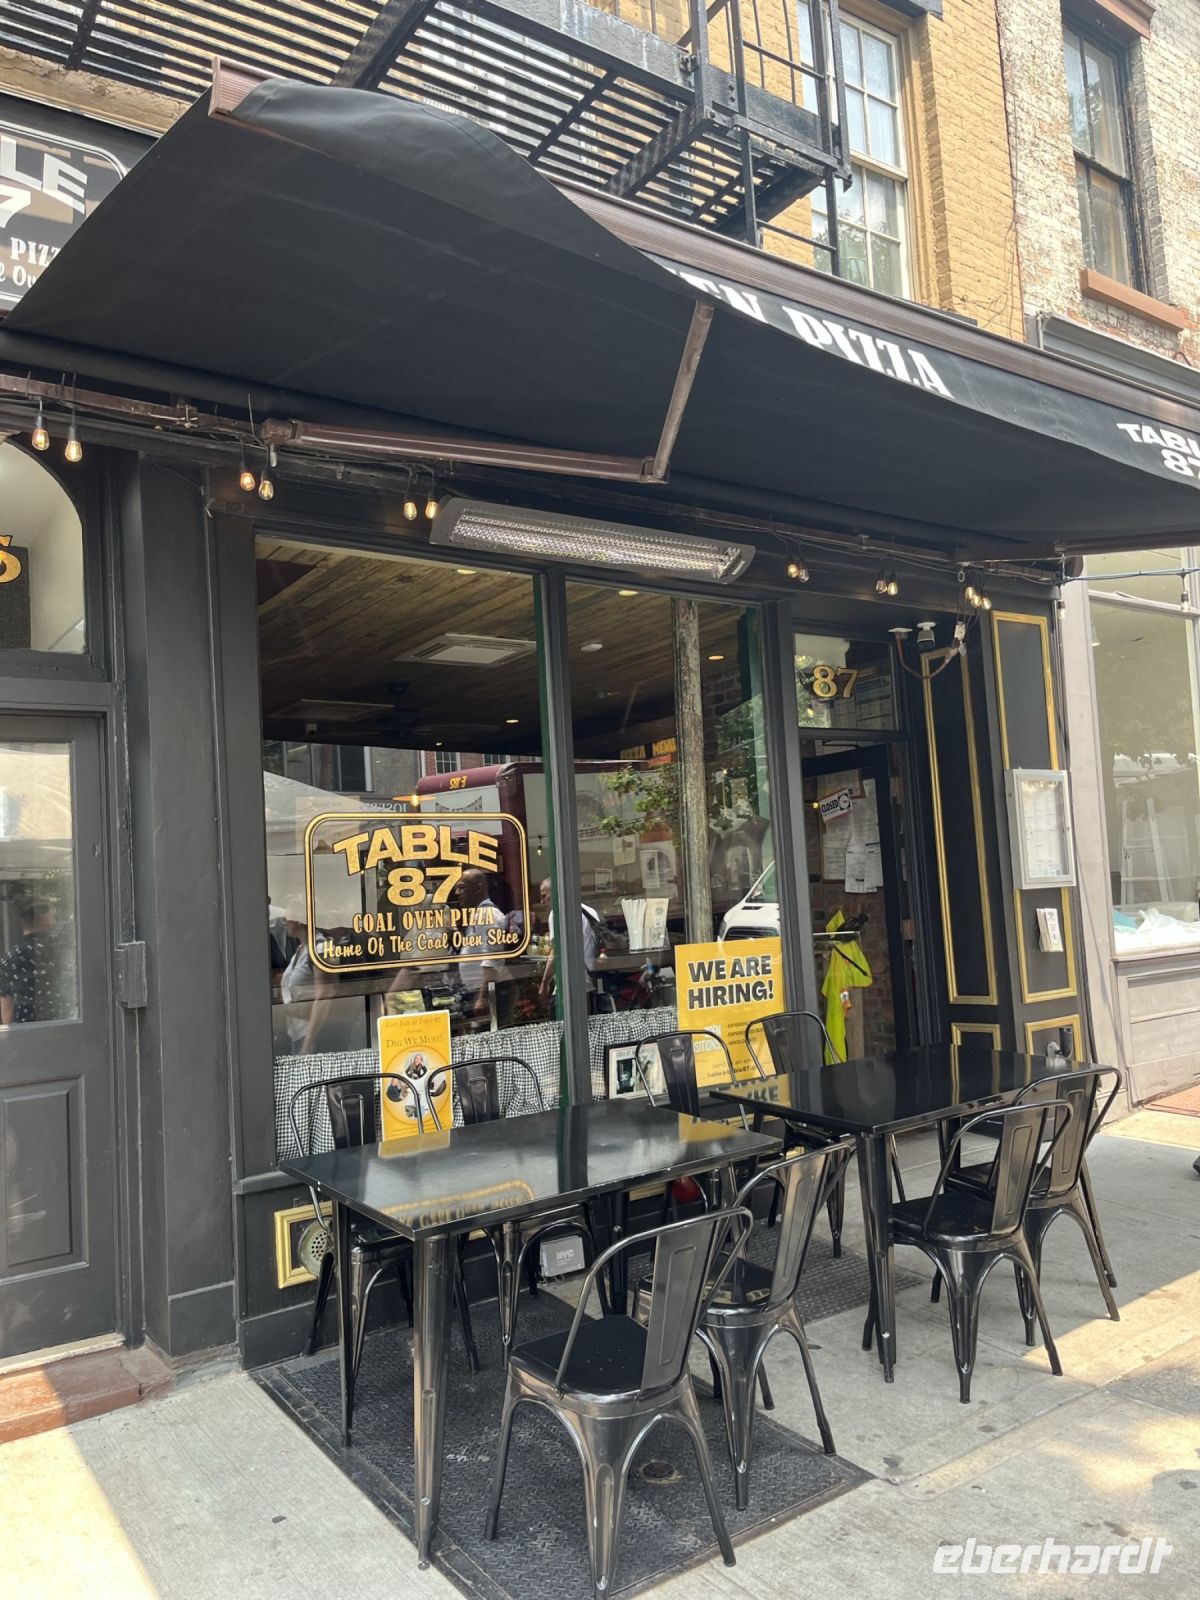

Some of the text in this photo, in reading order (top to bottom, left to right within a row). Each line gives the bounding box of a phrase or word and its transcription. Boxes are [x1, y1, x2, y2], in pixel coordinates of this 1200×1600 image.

[781, 305, 955, 399] PIZZA
[812, 664, 858, 699] 87
[333, 825, 499, 875] TABLE
[386, 866, 463, 907] 87
[352, 906, 495, 934] COAL OVEN PIZZA
[322, 926, 520, 960] Home Of The Coal Oven Slice
[688, 955, 772, 982] WE ARE
[687, 979, 774, 1011] HIRING!
[556, 1249, 575, 1259] NYC
